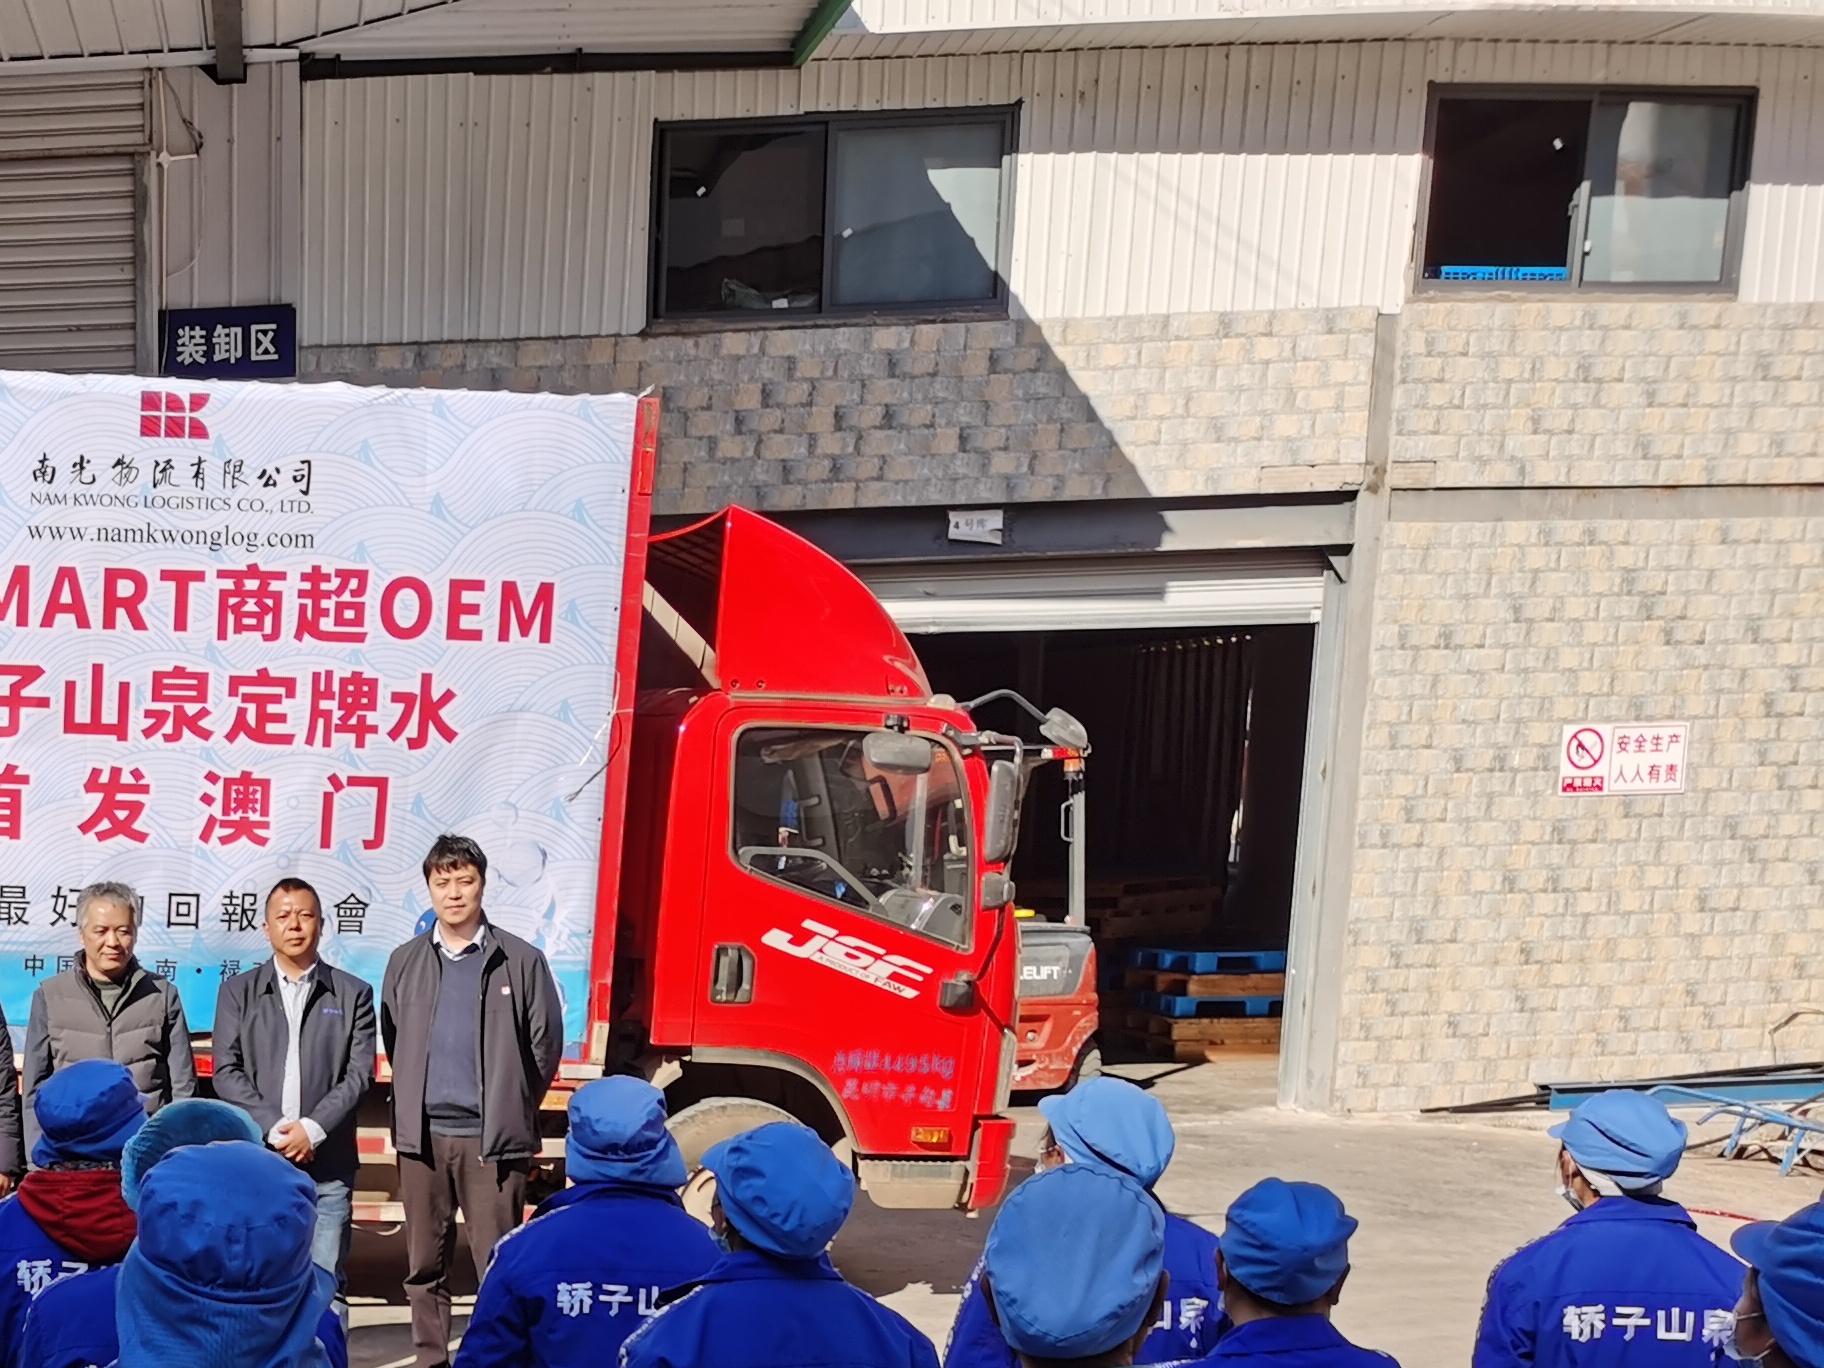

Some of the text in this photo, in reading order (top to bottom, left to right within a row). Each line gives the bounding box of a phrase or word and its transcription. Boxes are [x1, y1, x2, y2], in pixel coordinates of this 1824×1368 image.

[176, 324, 279, 366] 装卸区
[32, 452, 313, 496] 南光物流有限公司
[30, 491, 315, 515] NAM KWONG LOGISTICS CO., LTD.
[26, 522, 316, 553] www.namkwonglog.com
[1616, 733, 1682, 754] 安全生产
[1614, 764, 1679, 783] 人人有责
[873, 976, 907, 993] FAW
[1563, 1304, 1737, 1347] 轿子山泉
